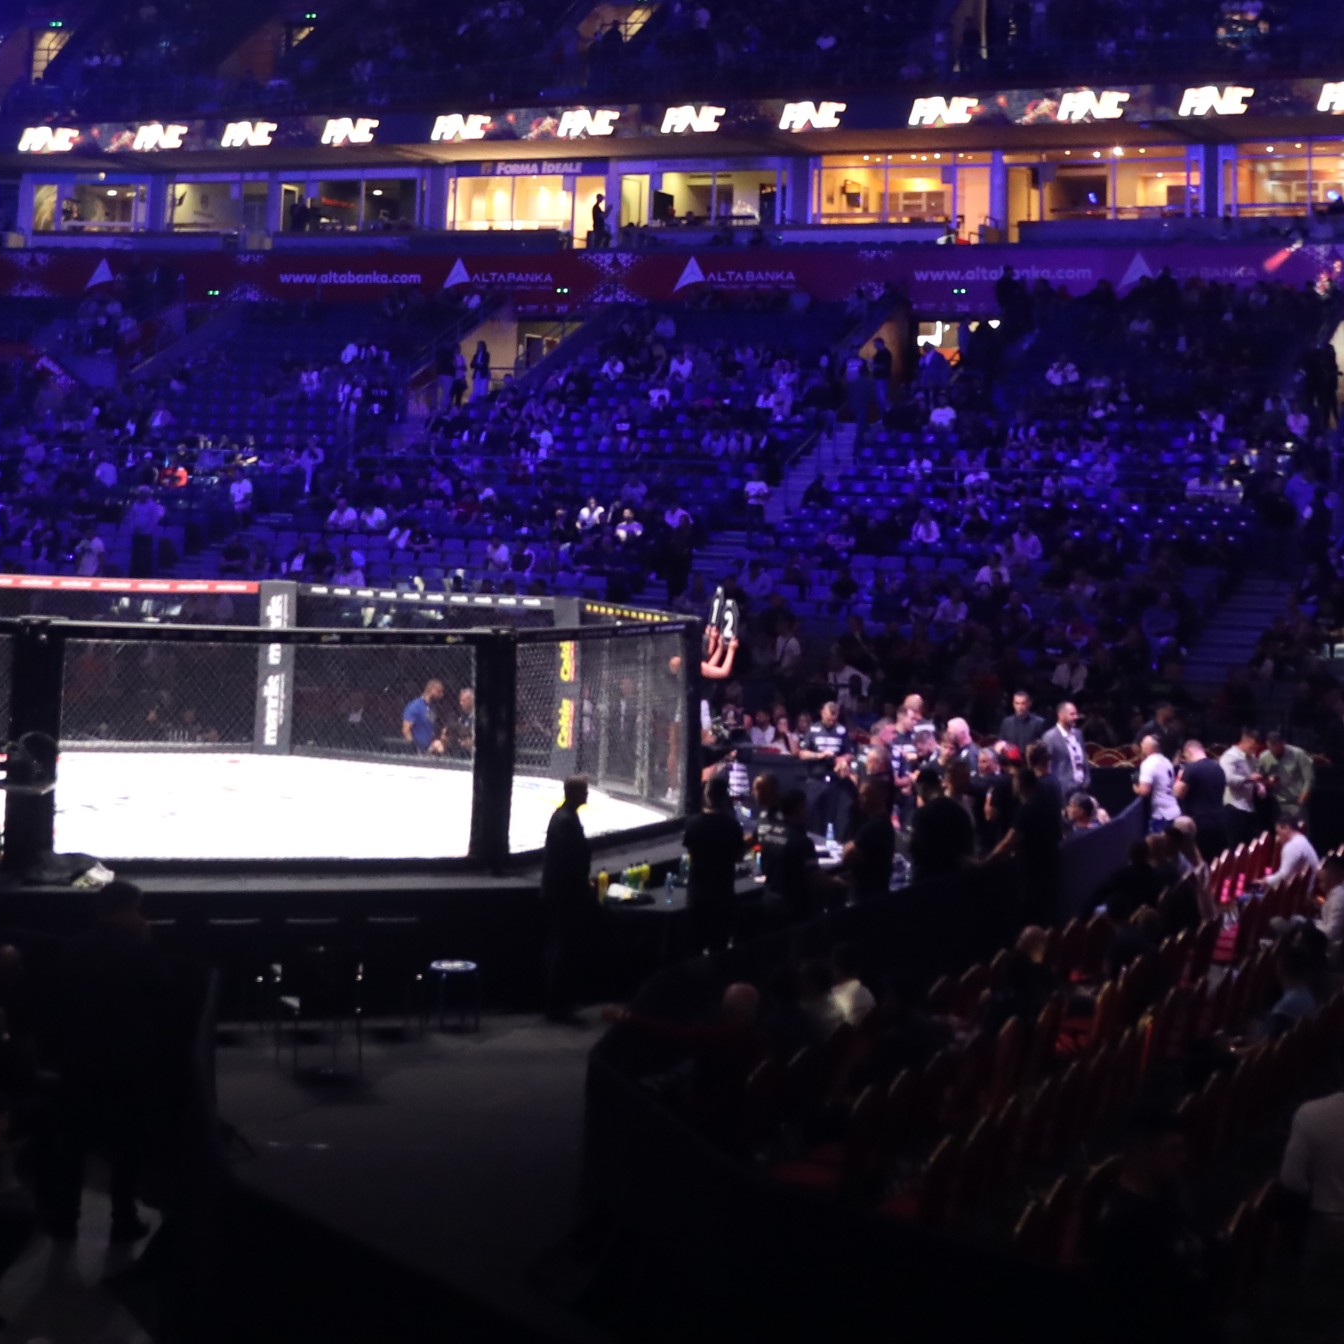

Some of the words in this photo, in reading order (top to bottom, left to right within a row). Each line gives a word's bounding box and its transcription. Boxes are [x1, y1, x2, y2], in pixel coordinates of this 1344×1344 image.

[778, 101, 847, 130] FNC
[908, 96, 979, 127] FNC
[1056, 90, 1131, 121] FNC
[1178, 85, 1255, 117] FNC
[220, 120, 278, 148] FNC
[320, 117, 380, 146] FNC
[430, 113, 492, 142] FNC
[556, 108, 621, 138] FNC
[660, 105, 726, 134] FNC
[17, 126, 80, 153] FNC
[132, 121, 189, 150] FNC
[279, 270, 422, 285] www.altabanka.com
[471, 272, 553, 284] ALTABANKA
[706, 270, 796, 283] ALTABANKA
[711, 598, 720, 625] 1
[722, 609, 734, 638] 2
